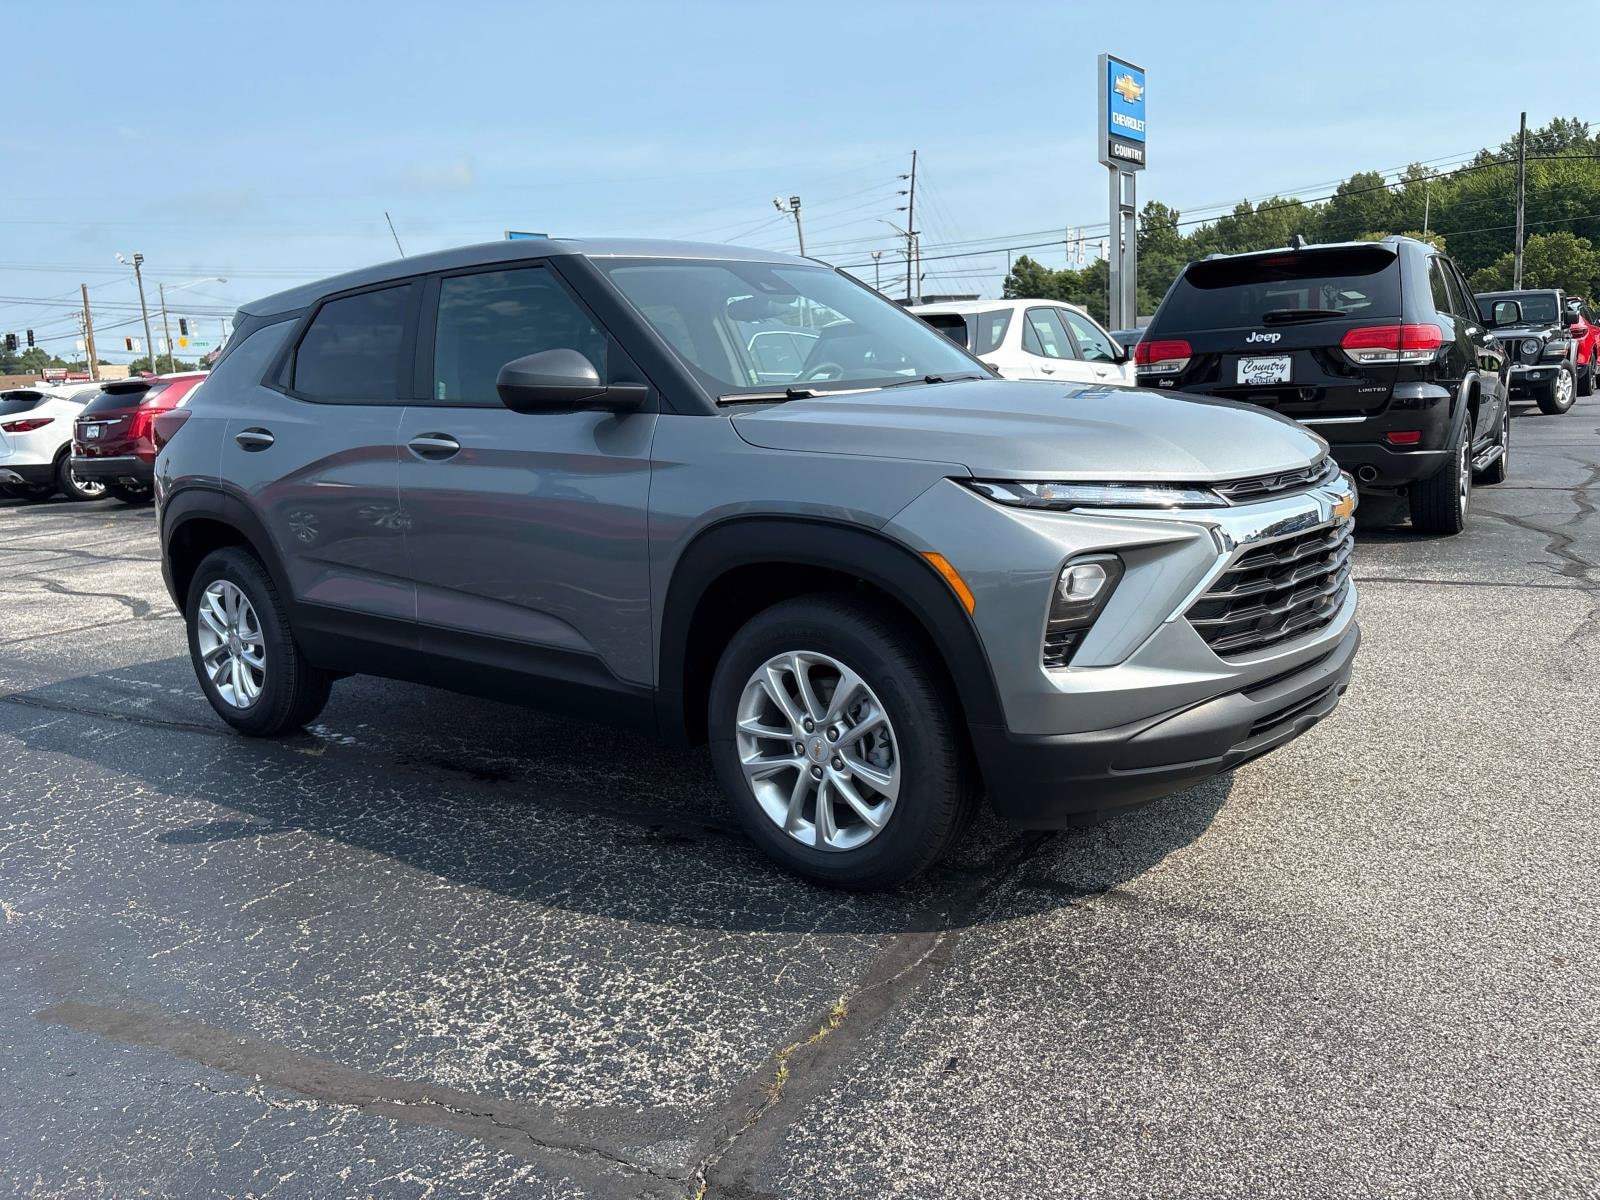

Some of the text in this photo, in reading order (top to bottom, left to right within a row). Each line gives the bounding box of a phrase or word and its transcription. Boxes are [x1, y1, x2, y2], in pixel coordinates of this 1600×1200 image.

[1112, 111, 1145, 133] CHEVROLET
[1114, 143, 1143, 161] COUNTRY
[1245, 331, 1281, 344] Jeep
[1242, 360, 1287, 374] Country
